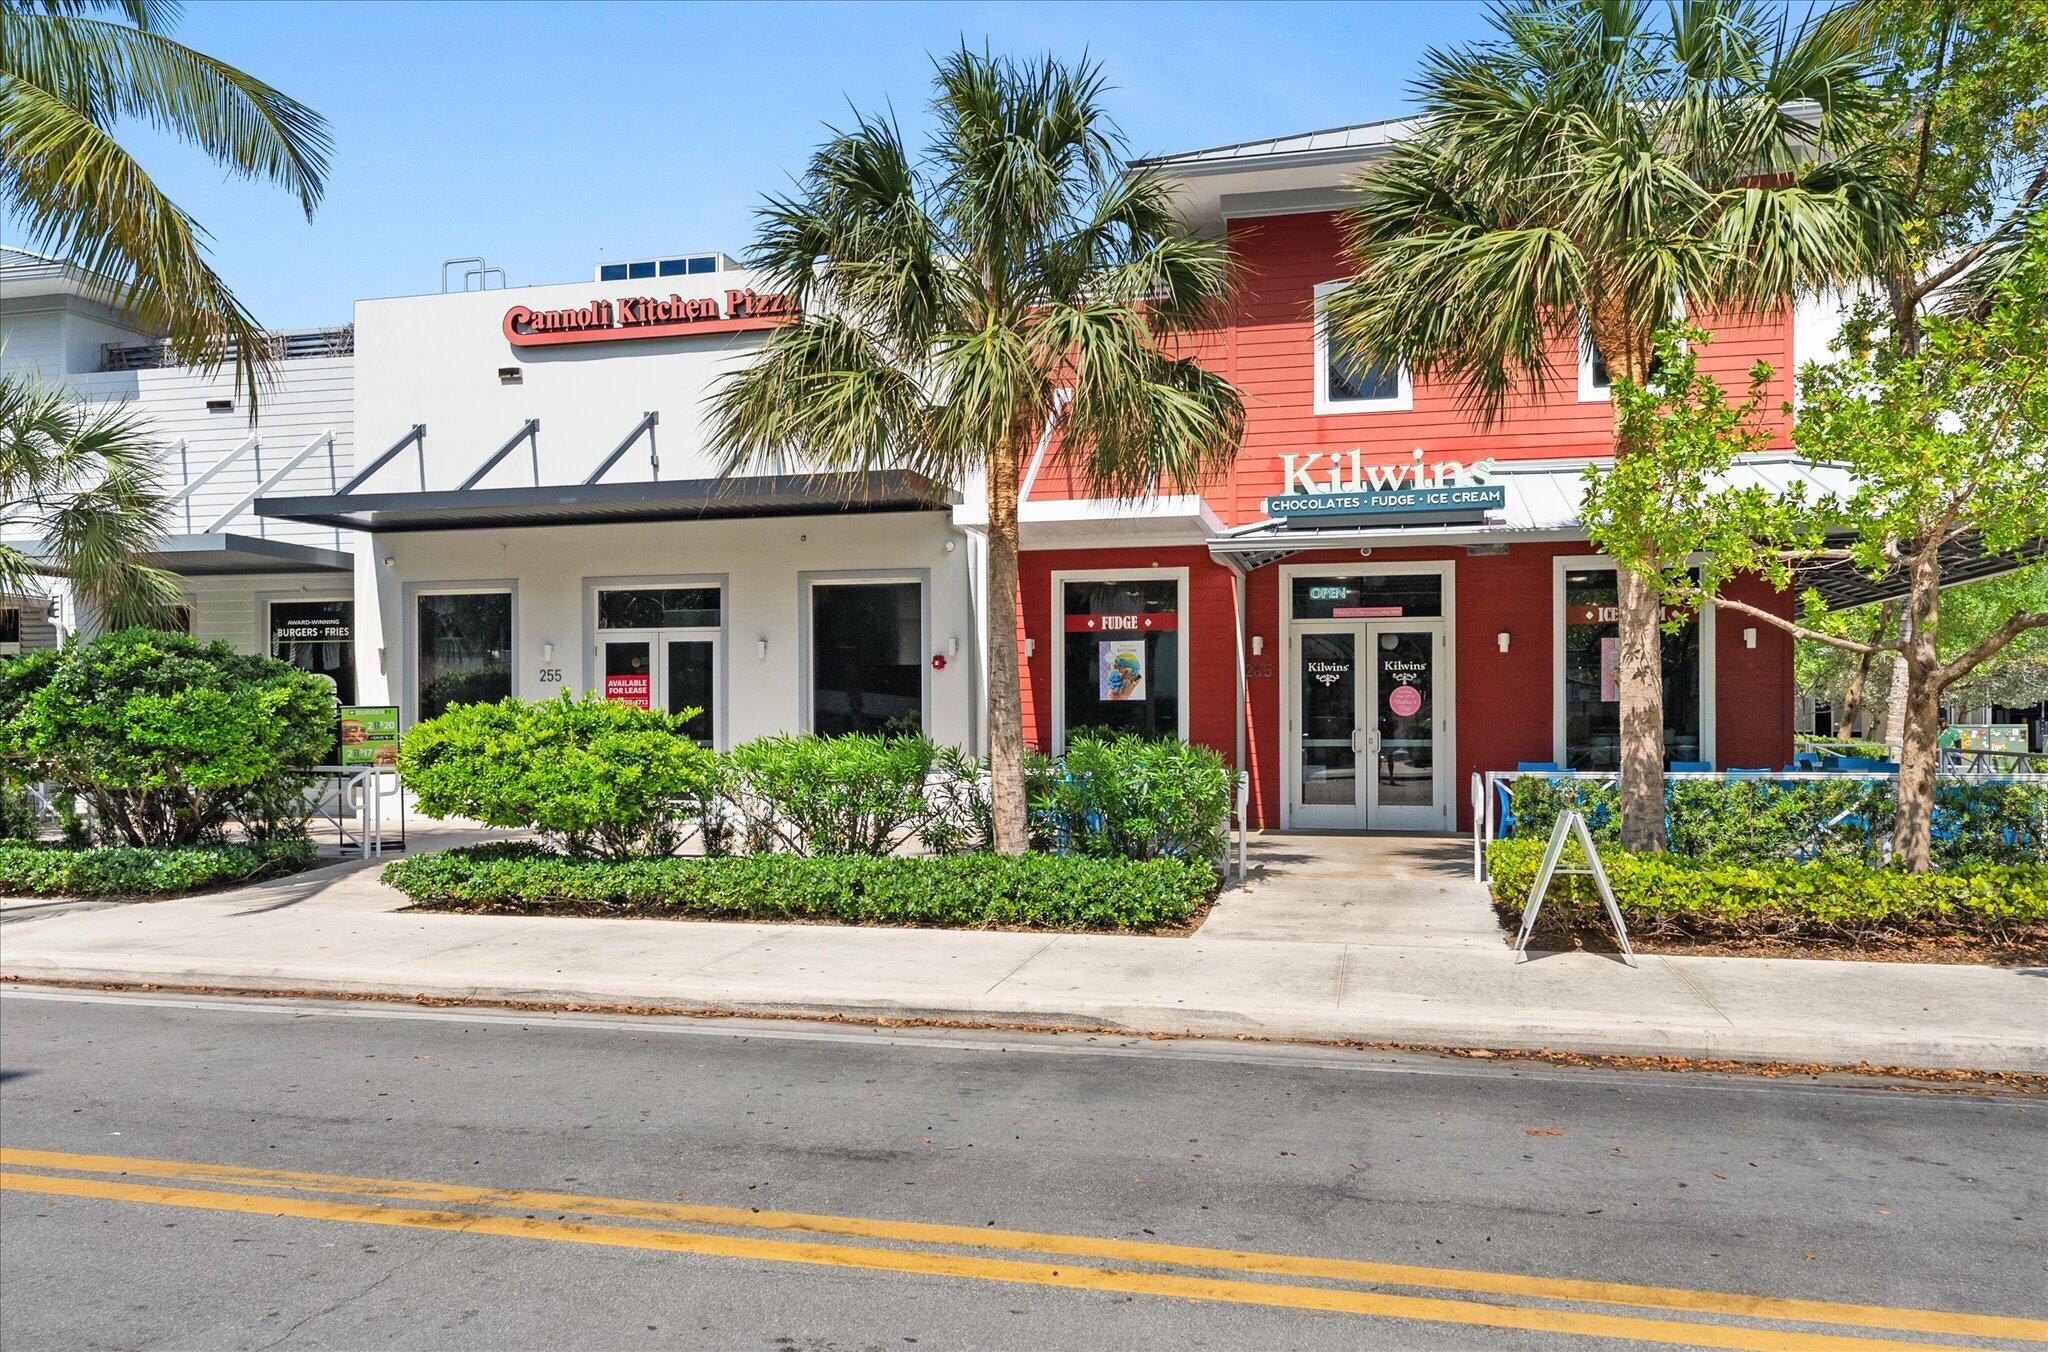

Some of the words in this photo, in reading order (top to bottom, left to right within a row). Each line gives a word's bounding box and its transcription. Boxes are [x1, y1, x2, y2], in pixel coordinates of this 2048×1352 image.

[502, 299, 611, 340] Cannoli
[616, 293, 717, 325] Kitchen
[1278, 447, 1495, 496] Kilwins
[1271, 497, 1360, 512] CHOCOLATES
[1371, 494, 1415, 507] FUDGE
[1427, 492, 1449, 504] ICE
[1452, 490, 1501, 503] CREAM
[1309, 587, 1347, 599] OPEN
[1598, 607, 1618, 622] ICE
[1101, 615, 1138, 630] FUDGE
[277, 627, 318, 637] BURGERS
[324, 627, 350, 637] FRIES
[1308, 662, 1349, 672] Kilwins
[1384, 661, 1427, 671] Kilwins
[539, 669, 562, 682] 255
[608, 679, 647, 687] AVAILABLE
